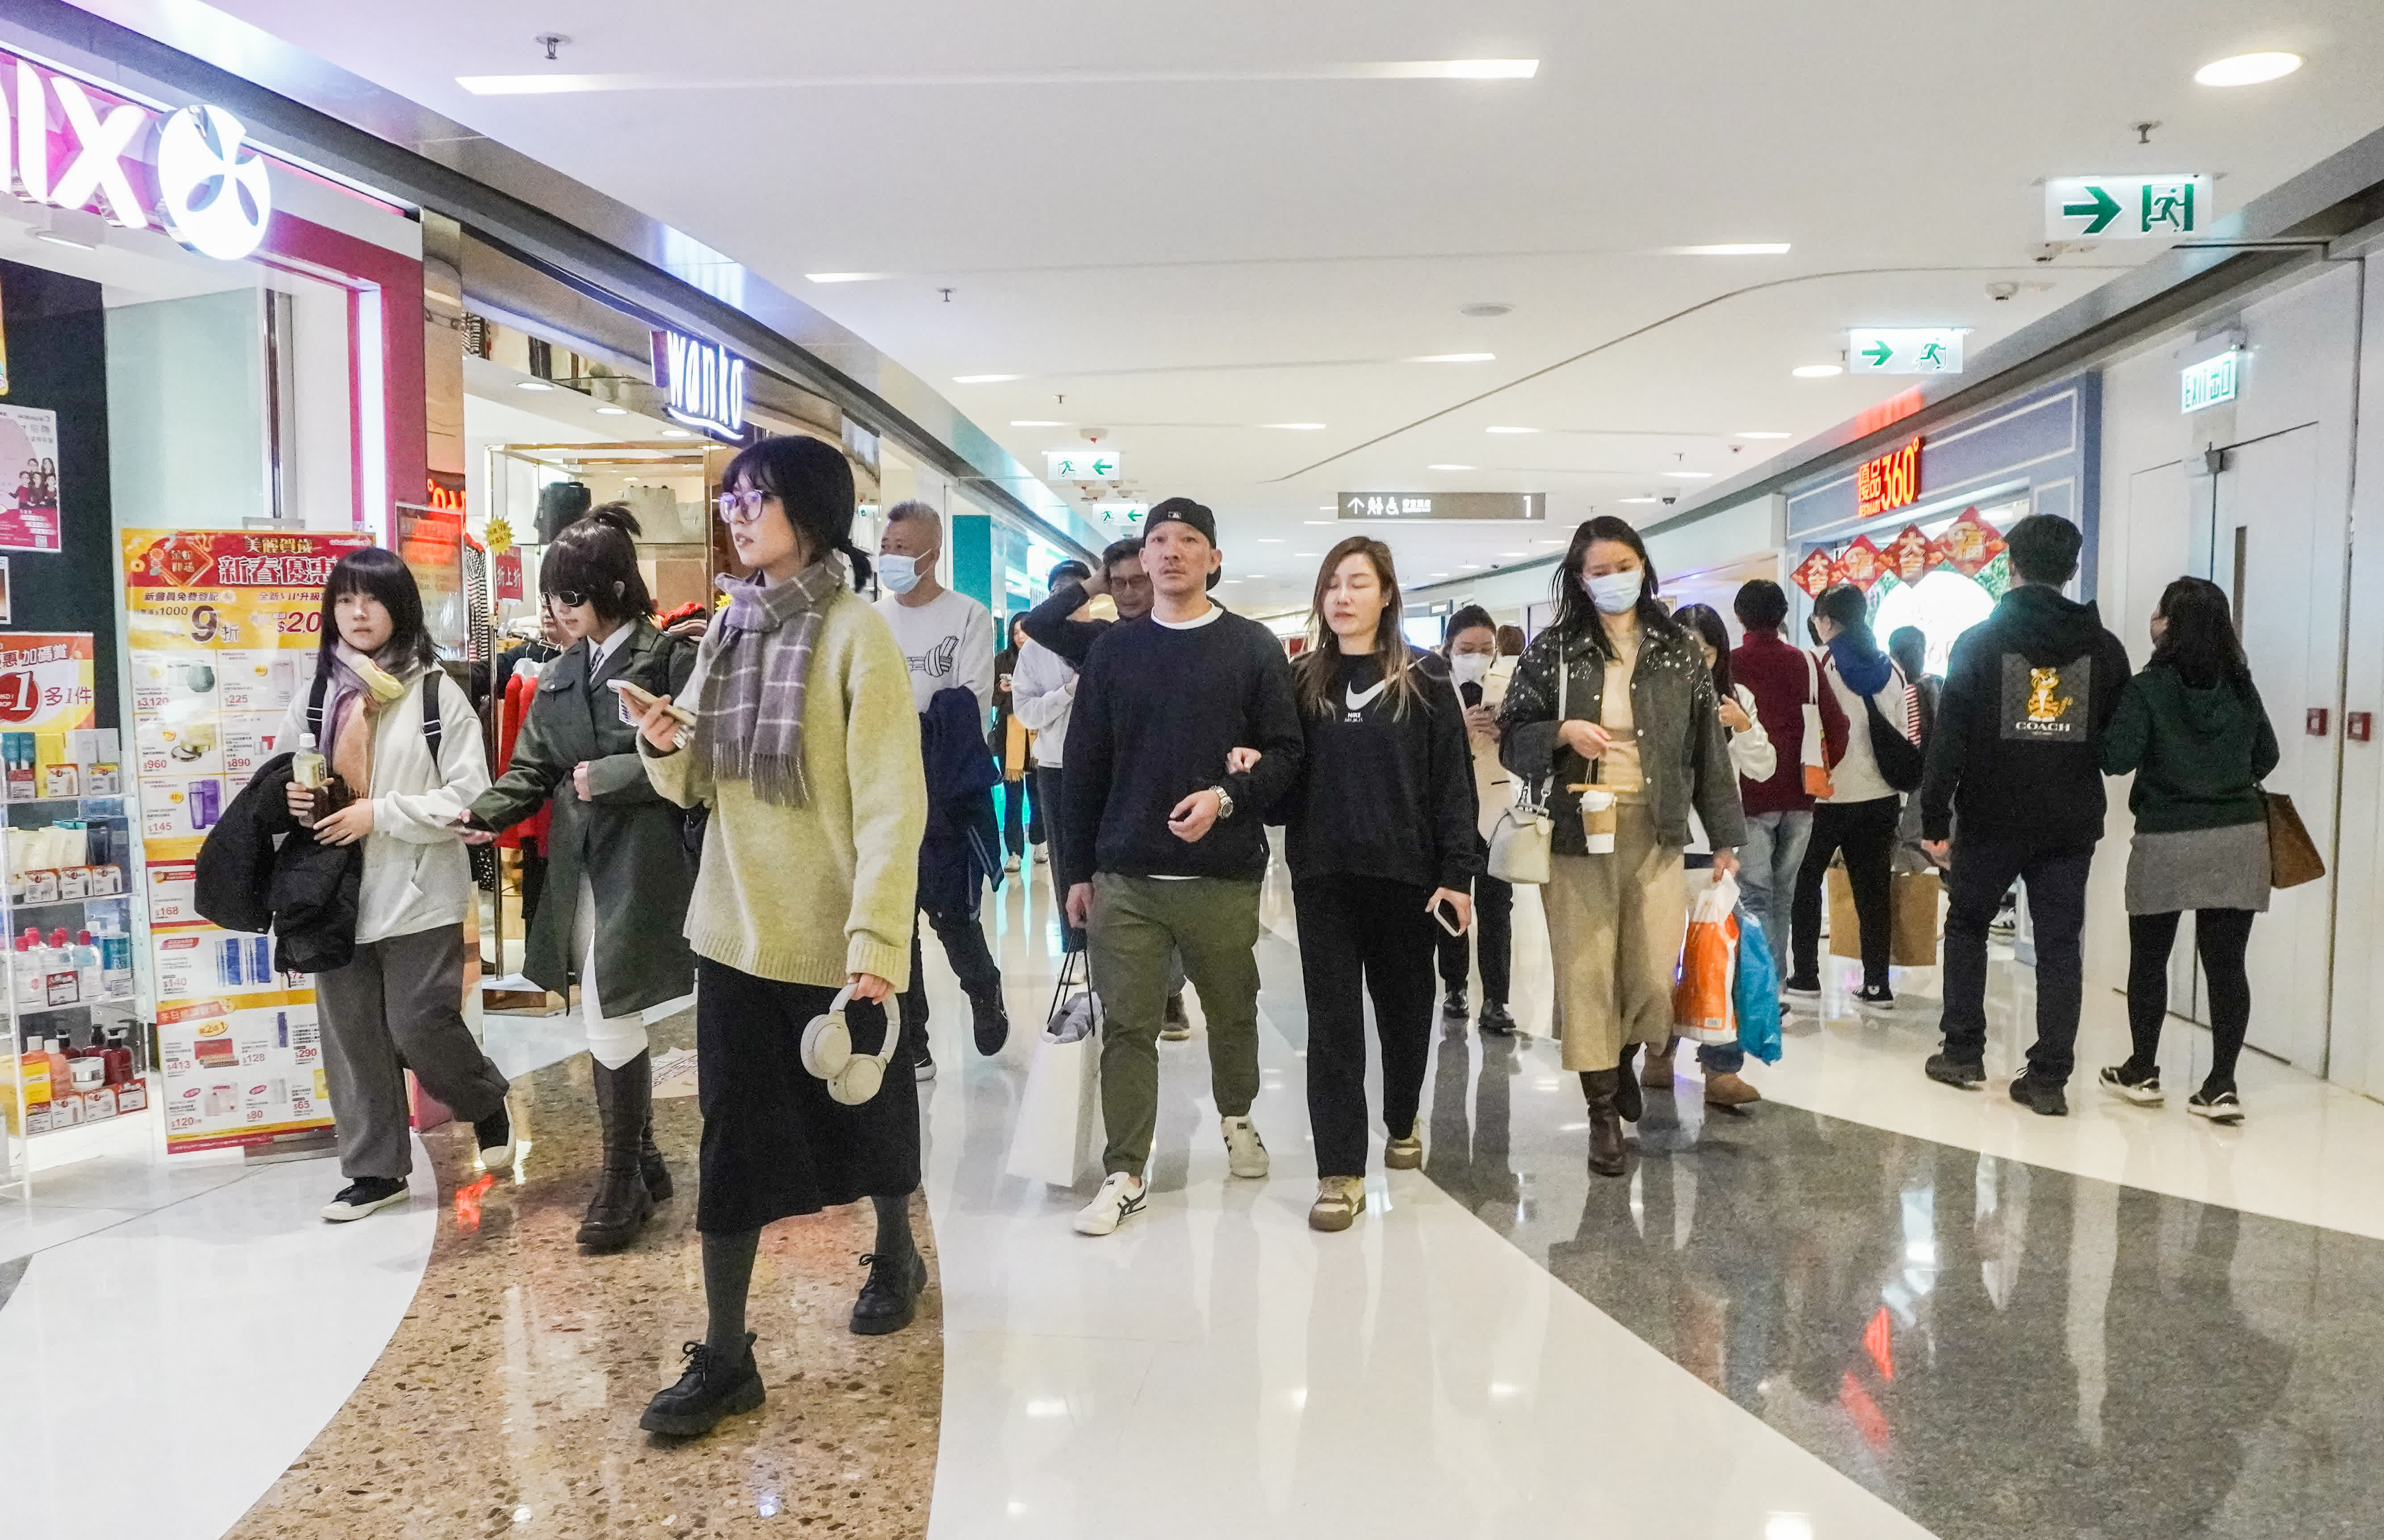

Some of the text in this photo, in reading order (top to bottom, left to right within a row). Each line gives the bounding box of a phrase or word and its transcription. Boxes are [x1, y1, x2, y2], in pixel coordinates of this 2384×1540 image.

[2185, 359, 2231, 408] EXIT 出口
[1523, 495, 1531, 518] 1
[1898, 532, 1926, 579] 大吉
[2015, 722, 2070, 732] COACH
[143, 759, 167, 769] $960
[228, 758, 251, 768] $890
[148, 822, 172, 833] $145
[168, 1061, 190, 1070] $413
[294, 1102, 311, 1110] $65
